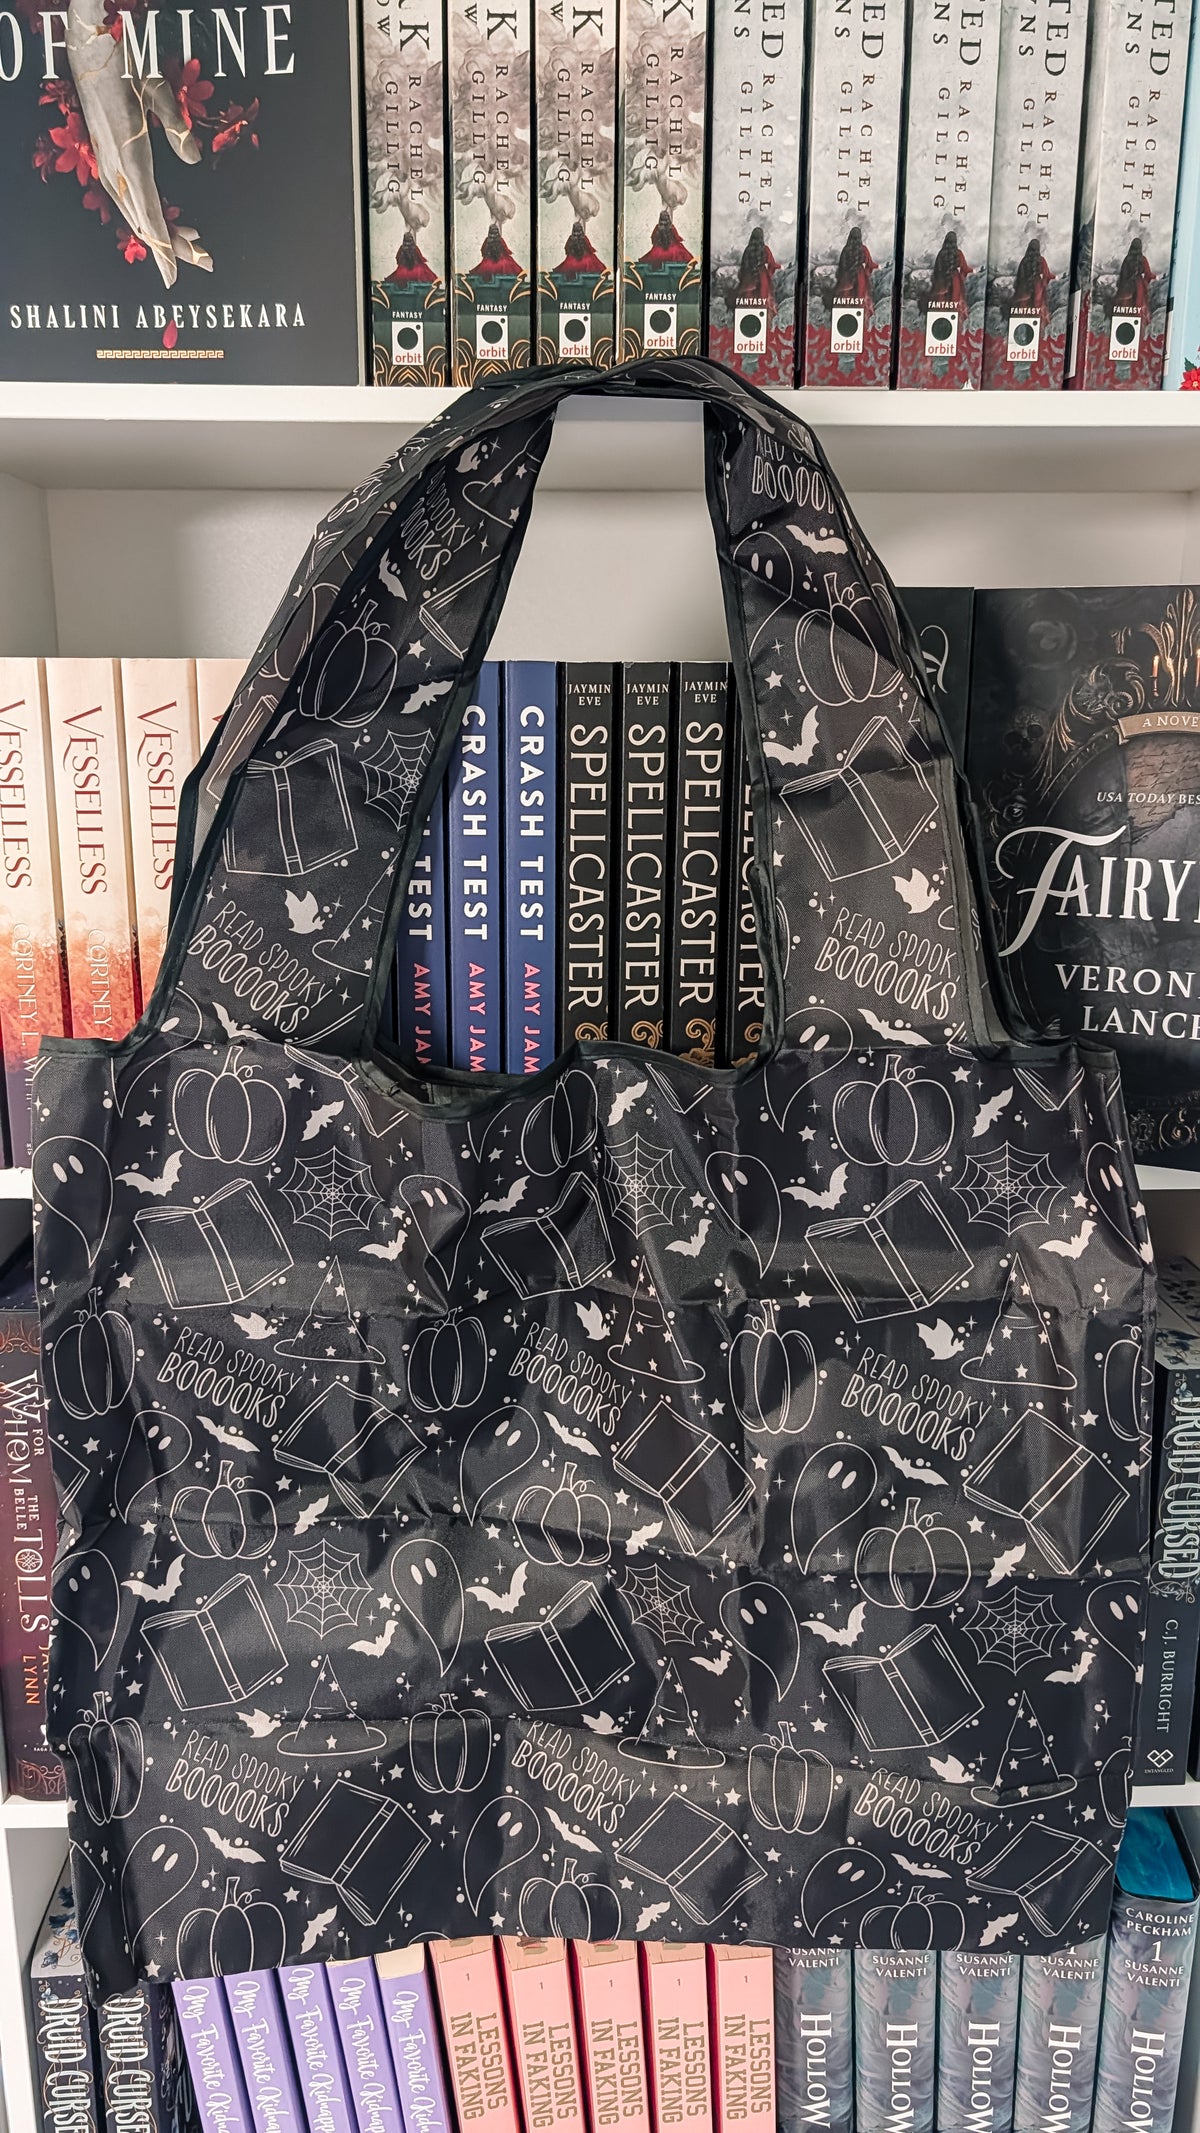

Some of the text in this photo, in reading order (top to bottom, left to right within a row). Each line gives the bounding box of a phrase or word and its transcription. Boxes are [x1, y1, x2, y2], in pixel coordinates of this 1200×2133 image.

[0, 11, 69, 82] OF
[117, 4, 296, 79] MINE
[385, 81, 400, 193] GILLIG
[408, 75, 424, 200] RACHEL
[471, 70, 486, 184] GILLIG
[495, 64, 510, 192] RACHEL
[557, 68, 571, 182] GILLIG
[581, 62, 594, 190] RACHEL
[645, 53, 660, 170] GILLIG
[669, 47, 684, 177] RACHEL
[738, 81, 754, 204] GILLIG
[759, 73, 776, 212] RACHEL
[836, 81, 853, 204] GILLIG
[857, 73, 876, 212] RACHEL
[933, 87, 951, 209] GILLIG
[953, 80, 972, 216] RACHEL
[1016, 98, 1035, 216] GILLIG
[1036, 90, 1057, 224] RACHEL
[1120, 96, 1140, 215] GILLIG
[1139, 89, 1161, 223] RACHEL
[10, 302, 306, 330] SHALINI ABEYSEKARA
[392, 311, 423, 320] FANTASY
[476, 304, 508, 313] FANTASY
[559, 302, 591, 310] FANTASY
[645, 292, 677, 301] FANTASY
[736, 298, 767, 306] FANTASY
[833, 297, 864, 305] FANTASY
[928, 301, 958, 309] FANTASY
[1010, 307, 1041, 315] FANTASY
[1113, 306, 1142, 314] FANTASY
[395, 352, 422, 364] orbit
[479, 347, 507, 359] orbit
[562, 344, 589, 356] orbit
[646, 336, 674, 348] orbit
[737, 340, 764, 352] orbit
[834, 340, 861, 351] orbit
[928, 343, 955, 355] orbit
[1010, 348, 1036, 360] orbit
[1111, 347, 1137, 359] orbit
[568, 684, 611, 694] JAYMIN
[578, 696, 601, 706] EVE
[626, 683, 669, 694] JAYMIN
[637, 696, 659, 706] EVE
[685, 681, 727, 692] JAYMIN
[694, 694, 717, 703] EVE
[1143, 718, 1152, 727] A
[0, 699, 32, 888] VESSELLESS
[63, 705, 107, 894] VESSELLESS
[137, 701, 178, 890] VESSELLESS
[462, 705, 487, 836] CRASH
[520, 705, 544, 836] CRASH
[1097, 792, 1122, 802] USA
[1128, 792, 1174, 804] TODAY
[408, 856, 432, 940] TEST
[464, 855, 487, 940] TEST
[520, 856, 544, 940] TEST
[568, 724, 609, 1012] SPELLCASTER
[624, 723, 666, 1011] SPELLCASTER
[679, 722, 723, 1007] SPELLCASTER
[13, 922, 39, 1022] CORTNEY
[88, 929, 113, 1026] CORTNEY
[187, 924, 310, 1033] BOOOOKS
[213, 900, 333, 1009] READ SPOOKY
[815, 937, 957, 1020] BOOOOKS
[832, 907, 961, 983] READ SPOOK
[1055, 964, 1200, 999] VERON
[414, 963, 431, 1016] AMY
[469, 963, 486, 1015] AMY
[525, 963, 541, 1016] AMY
[157, 1352, 285, 1428] BOOOOKS
[174, 1326, 302, 1396] READ SPOOKY
[508, 1347, 621, 1436] BOOOOKS
[523, 1322, 632, 1409] READ SPOOKY
[857, 1347, 992, 1429] READ SPOOKY
[2, 1369, 42, 1484] WHOM
[32, 1428, 45, 1456] FOR
[841, 1373, 976, 1461] BOOOOKS
[14, 1488, 28, 1531] BELLE
[27, 1495, 40, 1522] THE
[1155, 1397, 1200, 1578] DRUID CURSED
[14, 1529, 50, 1633] TOLLS
[23, 1655, 40, 1705] LYNN
[1156, 1619, 1179, 1733] C.J. BURRIGHT
[165, 1758, 290, 1837] BOOOOKS
[182, 1729, 305, 1803] READ SPOOKY
[511, 1739, 625, 1833] BOOOOKS
[526, 1720, 642, 1805] READ SPOOKY
[854, 1782, 981, 1864] BOOOOKS
[872, 1768, 999, 1842] READ SPOOKY
[1125, 1907, 1195, 1924] CAROLINE
[1126, 1920, 1191, 1937] PECKHAM
[1152, 1941, 1162, 1962] 1
[287, 1967, 315, 2006] My
[338, 1977, 366, 2015] My
[788, 1957, 839, 1968] VALENTI
[872, 1954, 930, 1966] SUSANNE
[875, 1967, 927, 1978] VALENTI
[956, 1953, 1014, 1966] SUSANNE
[959, 1966, 1011, 1977] VALENTI
[1040, 1955, 1100, 1968] SUSANNE
[1042, 1967, 1095, 1980] VALENTI
[1124, 1959, 1185, 1975] SUSANNE
[1127, 1972, 1180, 1987] VALENTI
[37, 1998, 87, 2063] DRUID
[100, 1997, 149, 2062] DRUID
[182, 1985, 210, 2024] My
[232, 1980, 261, 2019] My
[391, 1990, 419, 2029] My
[191, 2023, 225, 2090] Favorite
[242, 2017, 275, 2084] Favorite
[295, 2004, 328, 2071] Favorite
[347, 2014, 379, 2080] Favorite
[398, 2028, 431, 2094] Favorite
[450, 2012, 485, 2120] IN FAKING
[476, 2012, 508, 2110] LESSONS
[522, 2021, 554, 2128] IN FAKING
[548, 2023, 578, 2119] LESSONS
[591, 2018, 620, 2125] IN FAKING
[616, 2021, 644, 2117] LESSONS
[658, 2017, 683, 2124] IN FAKING
[683, 2021, 707, 2116] LESSONS
[724, 2014, 747, 2120] IN FAKING
[749, 2018, 771, 2113] LESSONS
[800, 2012, 832, 2129] HOLLOW
